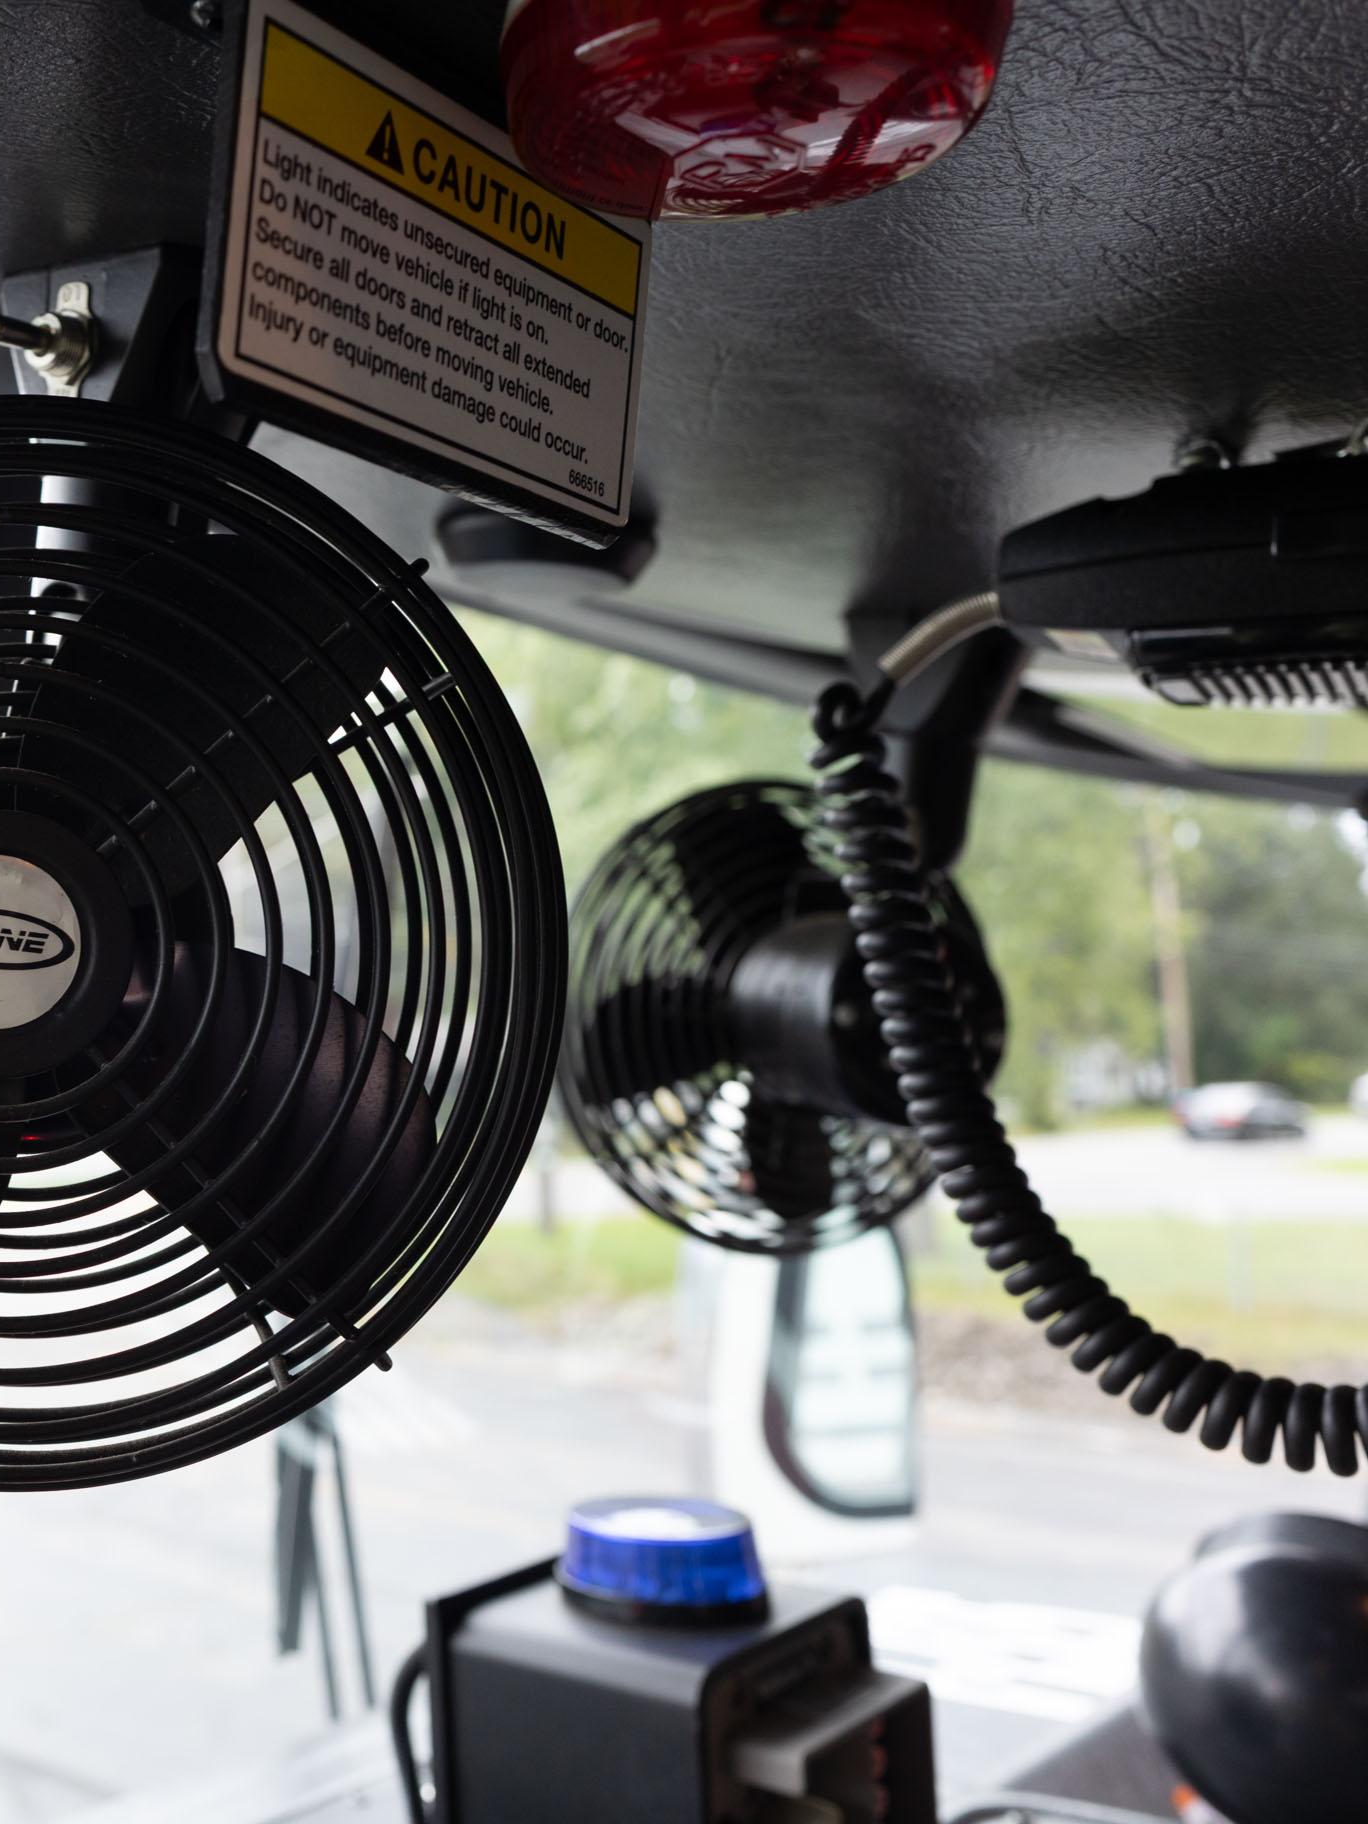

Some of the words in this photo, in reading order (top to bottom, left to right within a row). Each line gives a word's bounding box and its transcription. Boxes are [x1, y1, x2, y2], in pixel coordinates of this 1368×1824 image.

[259, 178, 287, 213] Do
[292, 195, 336, 236] NOT
[341, 225, 391, 265] move
[395, 251, 455, 297] vehicle
[458, 279, 469, 304] if
[472, 286, 507, 322] light
[510, 305, 523, 333] is
[526, 324, 549, 347] on.
[263, 139, 312, 187] Light
[317, 168, 399, 232] indicates
[403, 219, 491, 280] unsecured
[494, 267, 573, 325] equipment
[576, 312, 592, 333] or
[594, 319, 628, 353] door.
[412, 138, 566, 260] CAUTION
[251, 261, 371, 331] components
[376, 312, 432, 359] before
[435, 346, 495, 393] moving
[498, 374, 554, 416] vehicle.
[256, 216, 324, 270] Secure
[329, 257, 351, 283] all
[355, 267, 406, 311] doors
[410, 297, 443, 328] and
[446, 314, 500, 356] retract
[503, 341, 521, 366] all
[524, 353, 592, 399] extended
[308, 326, 329, 349] or
[333, 337, 428, 394] equipment
[431, 377, 497, 424] damage
[499, 411, 542, 445] could
[544, 430, 589, 466] occur.
[568, 468, 606, 498] 666516
